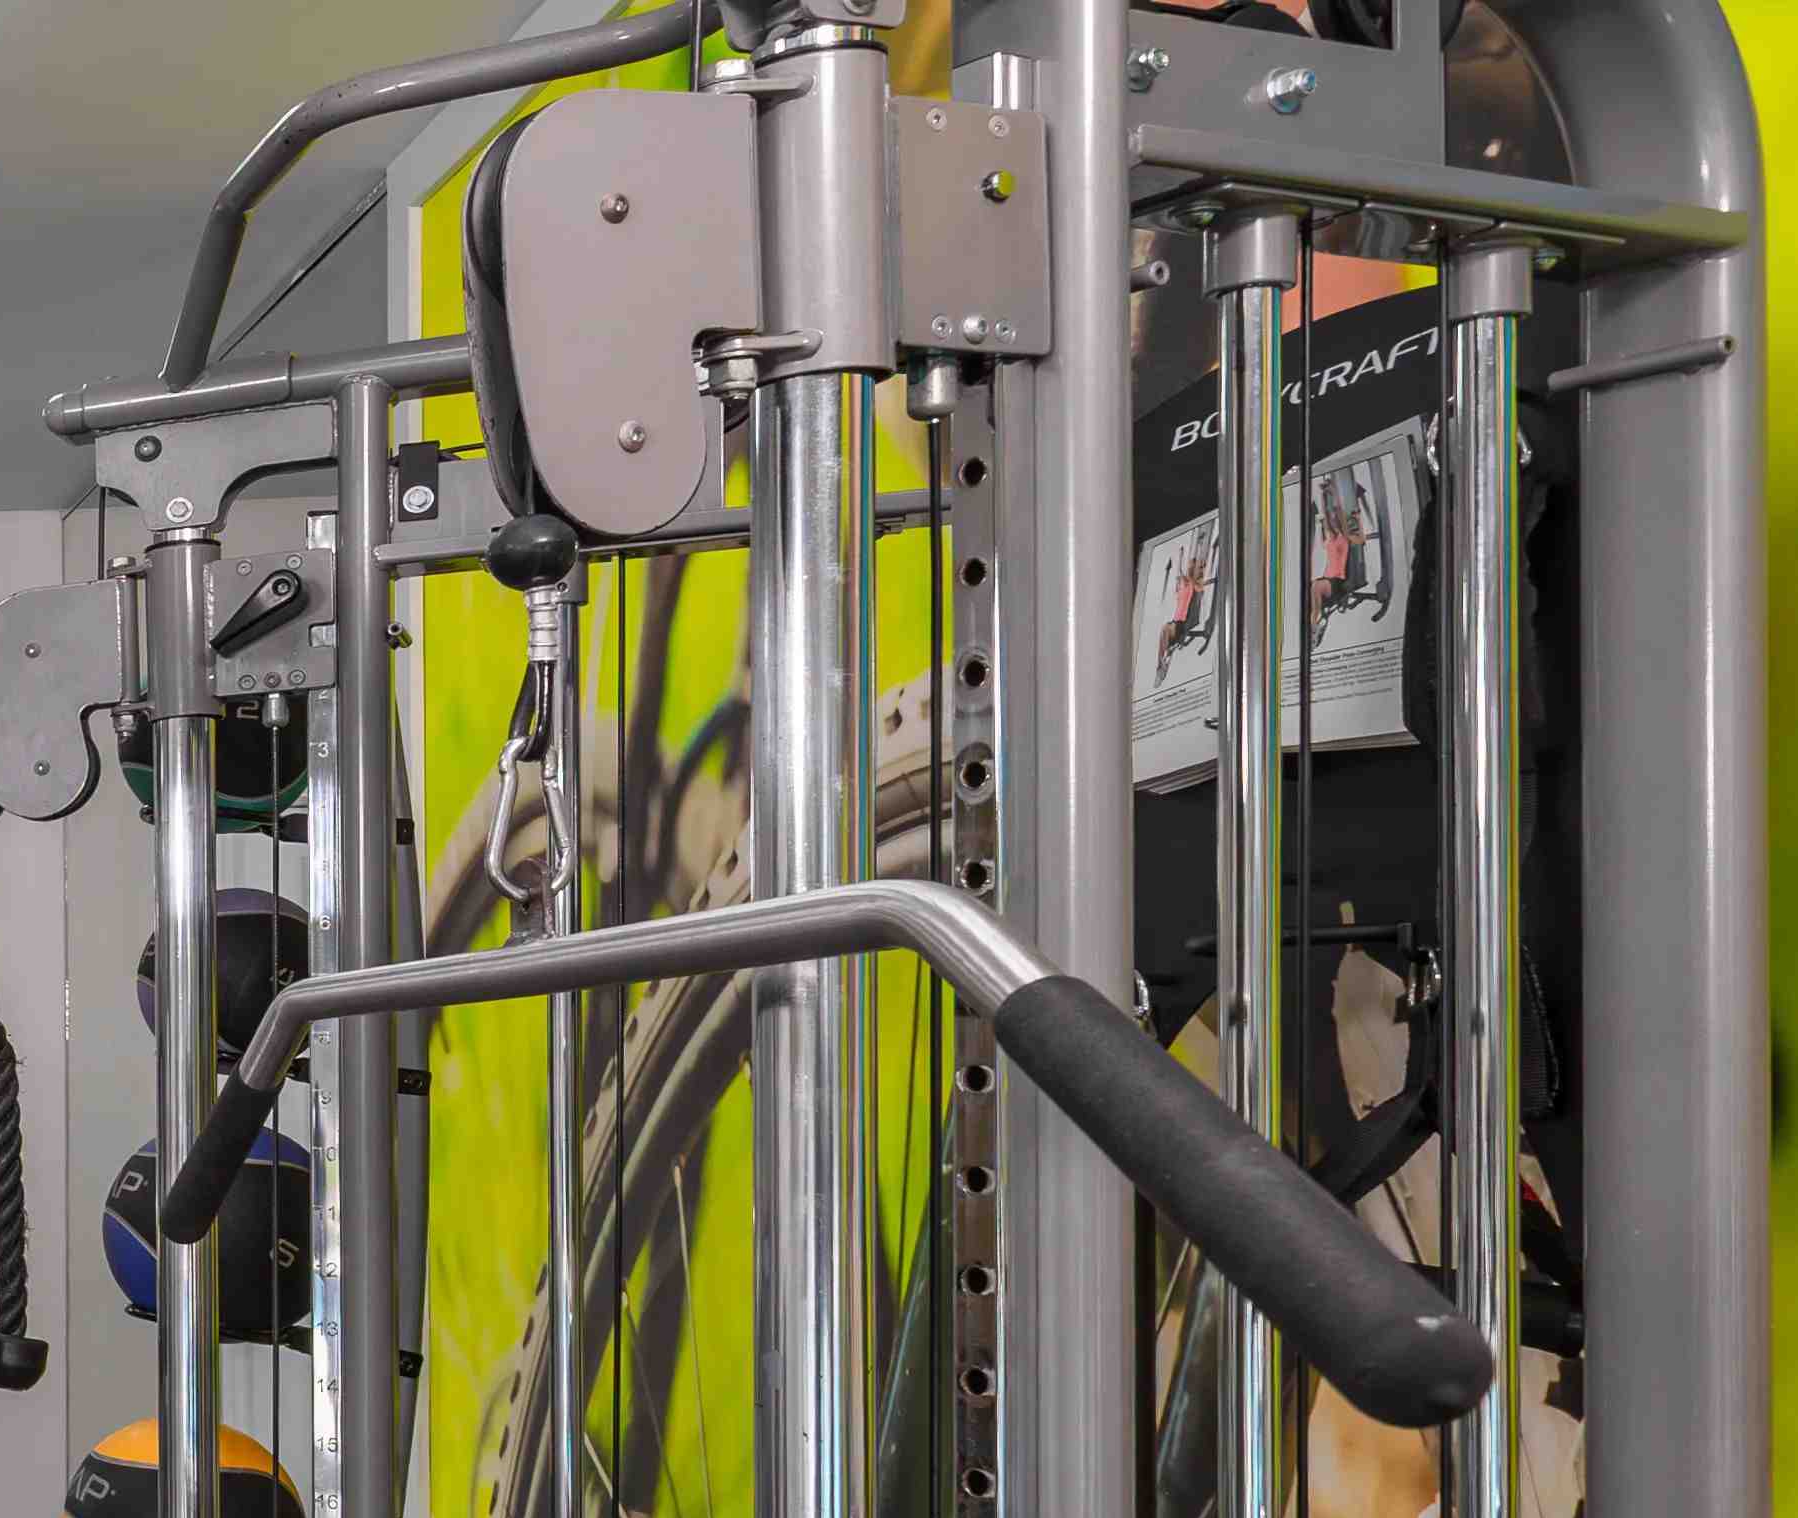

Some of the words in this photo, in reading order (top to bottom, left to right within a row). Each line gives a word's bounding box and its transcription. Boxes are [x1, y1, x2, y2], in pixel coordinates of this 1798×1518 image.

[316, 1378, 339, 1394] 14
[316, 1437, 339, 1453] 15
[316, 1494, 339, 1510] 16
